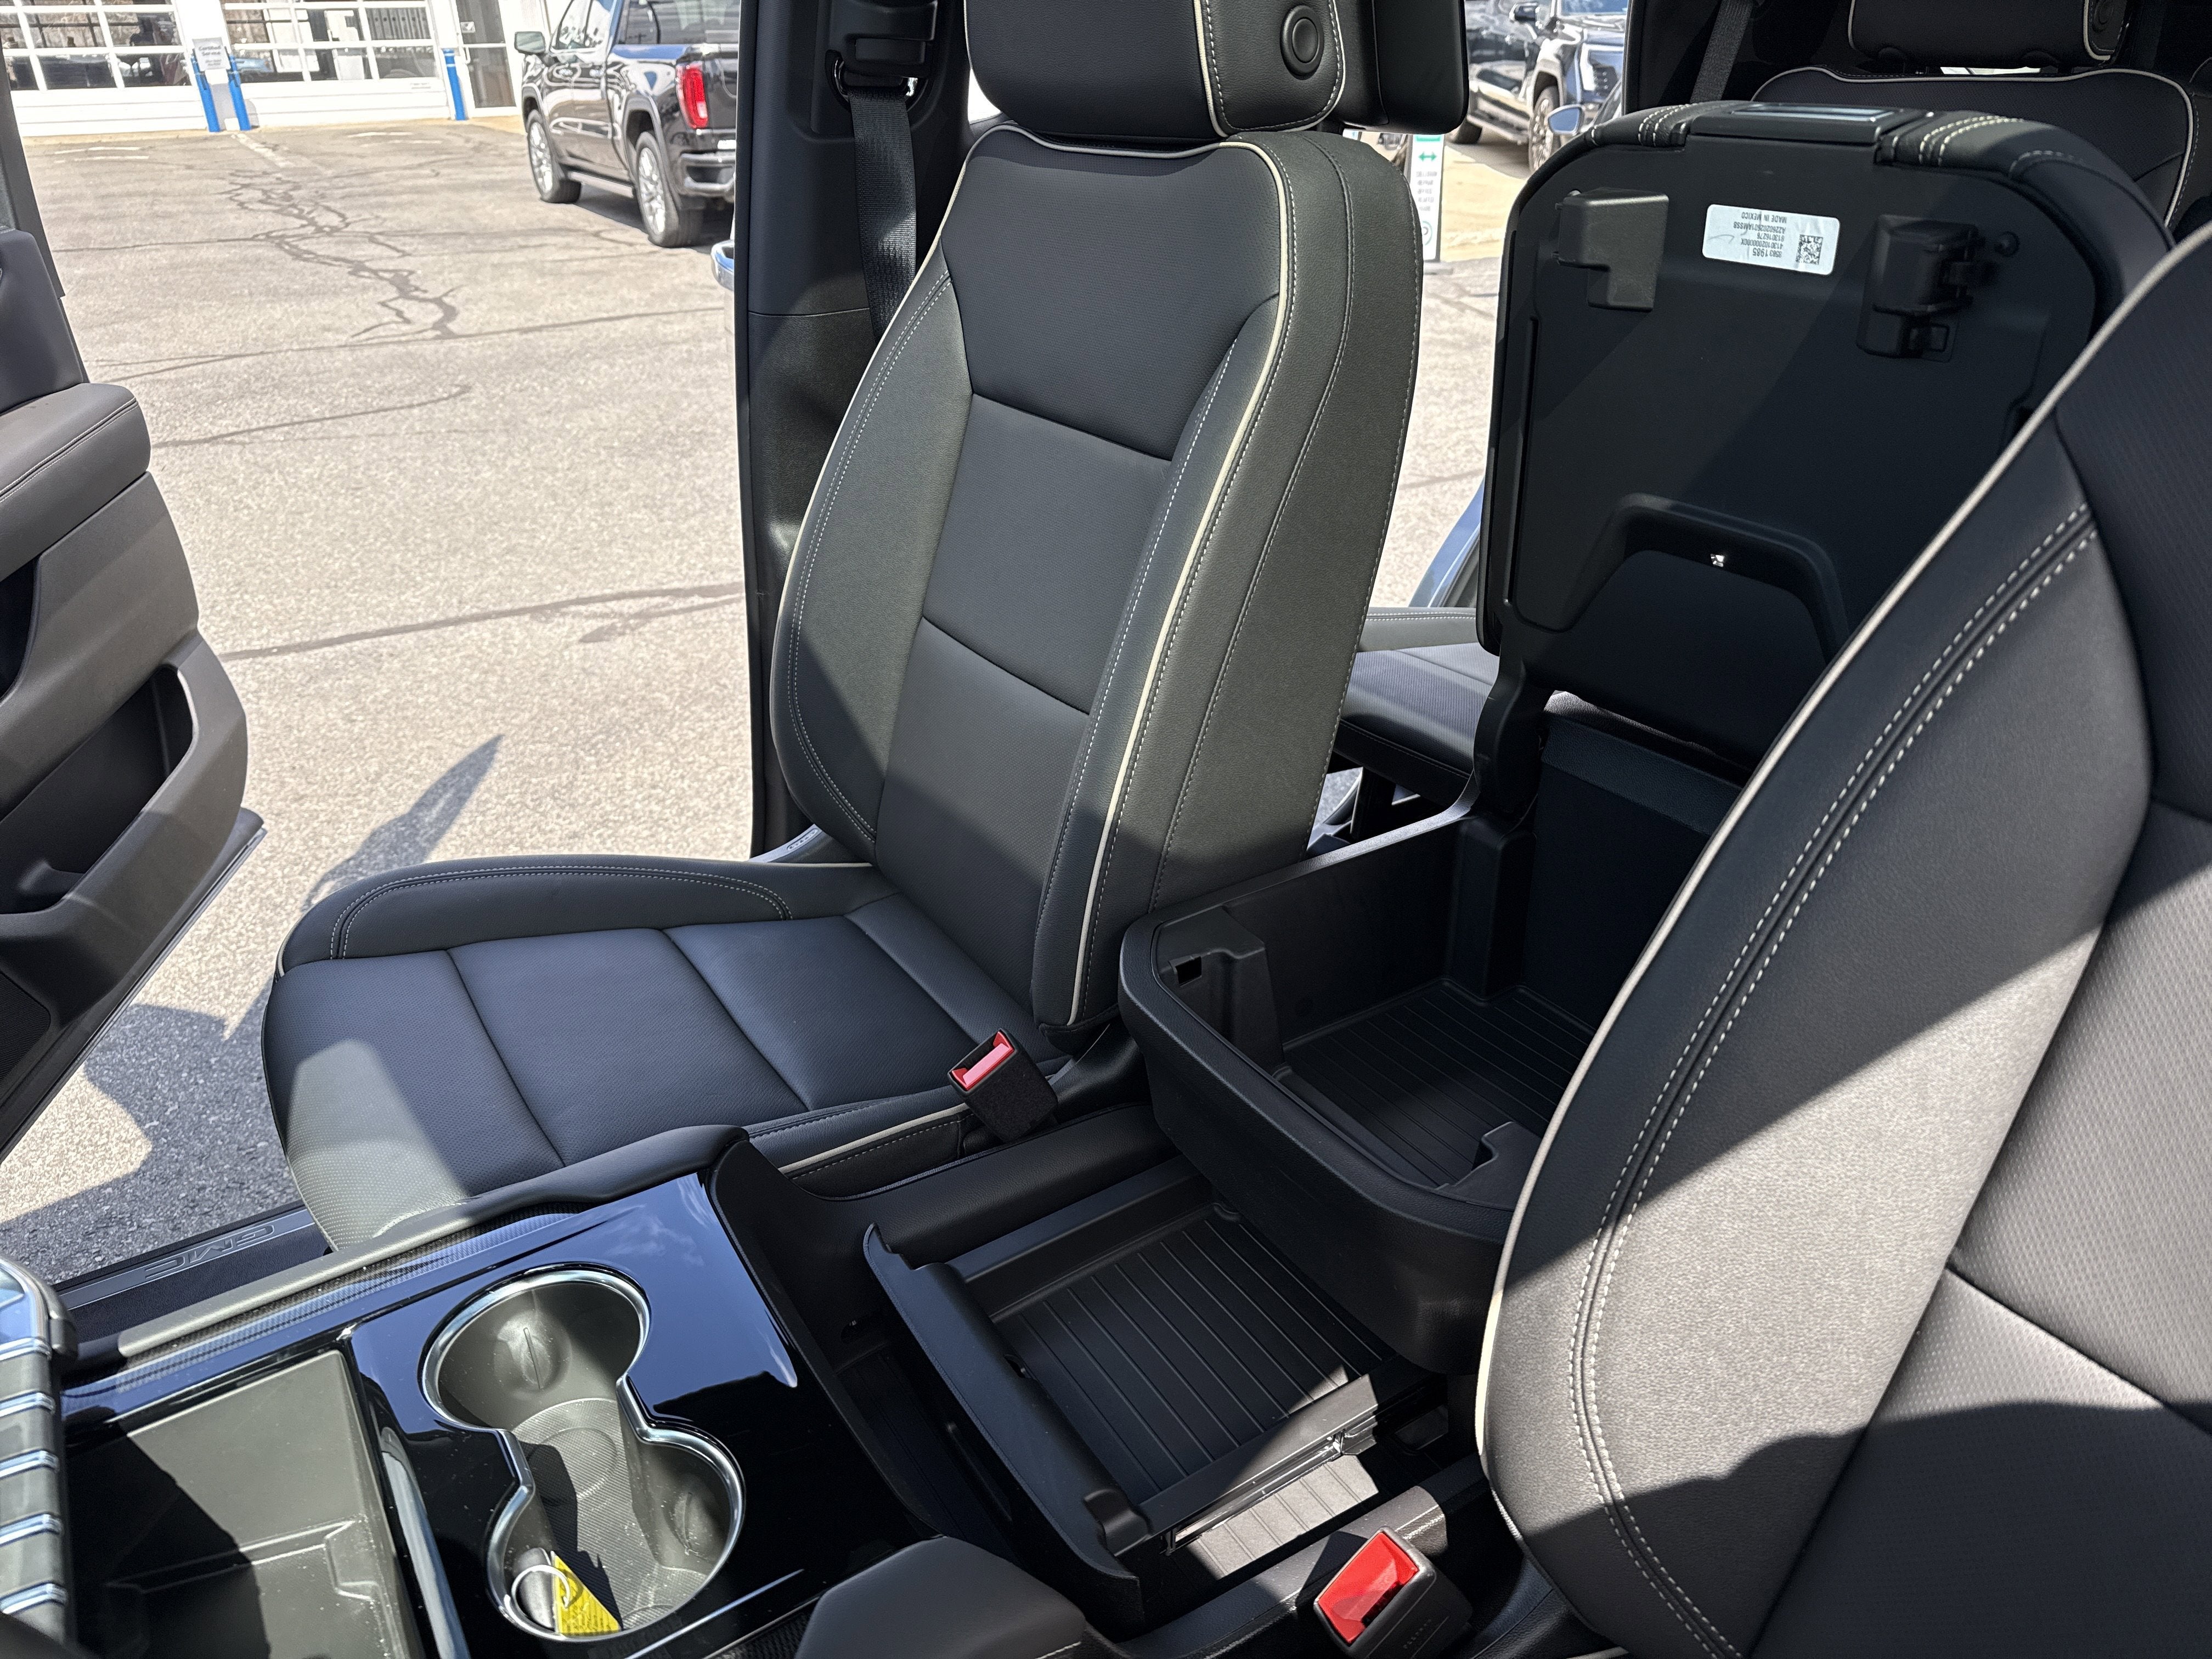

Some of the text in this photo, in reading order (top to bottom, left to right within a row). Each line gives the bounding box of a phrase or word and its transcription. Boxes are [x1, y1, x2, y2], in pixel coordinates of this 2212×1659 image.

[1741, 212, 1762, 220] MEXICO
[1752, 247, 1768, 257] 1985
[144, 1224, 275, 1279] GMC
